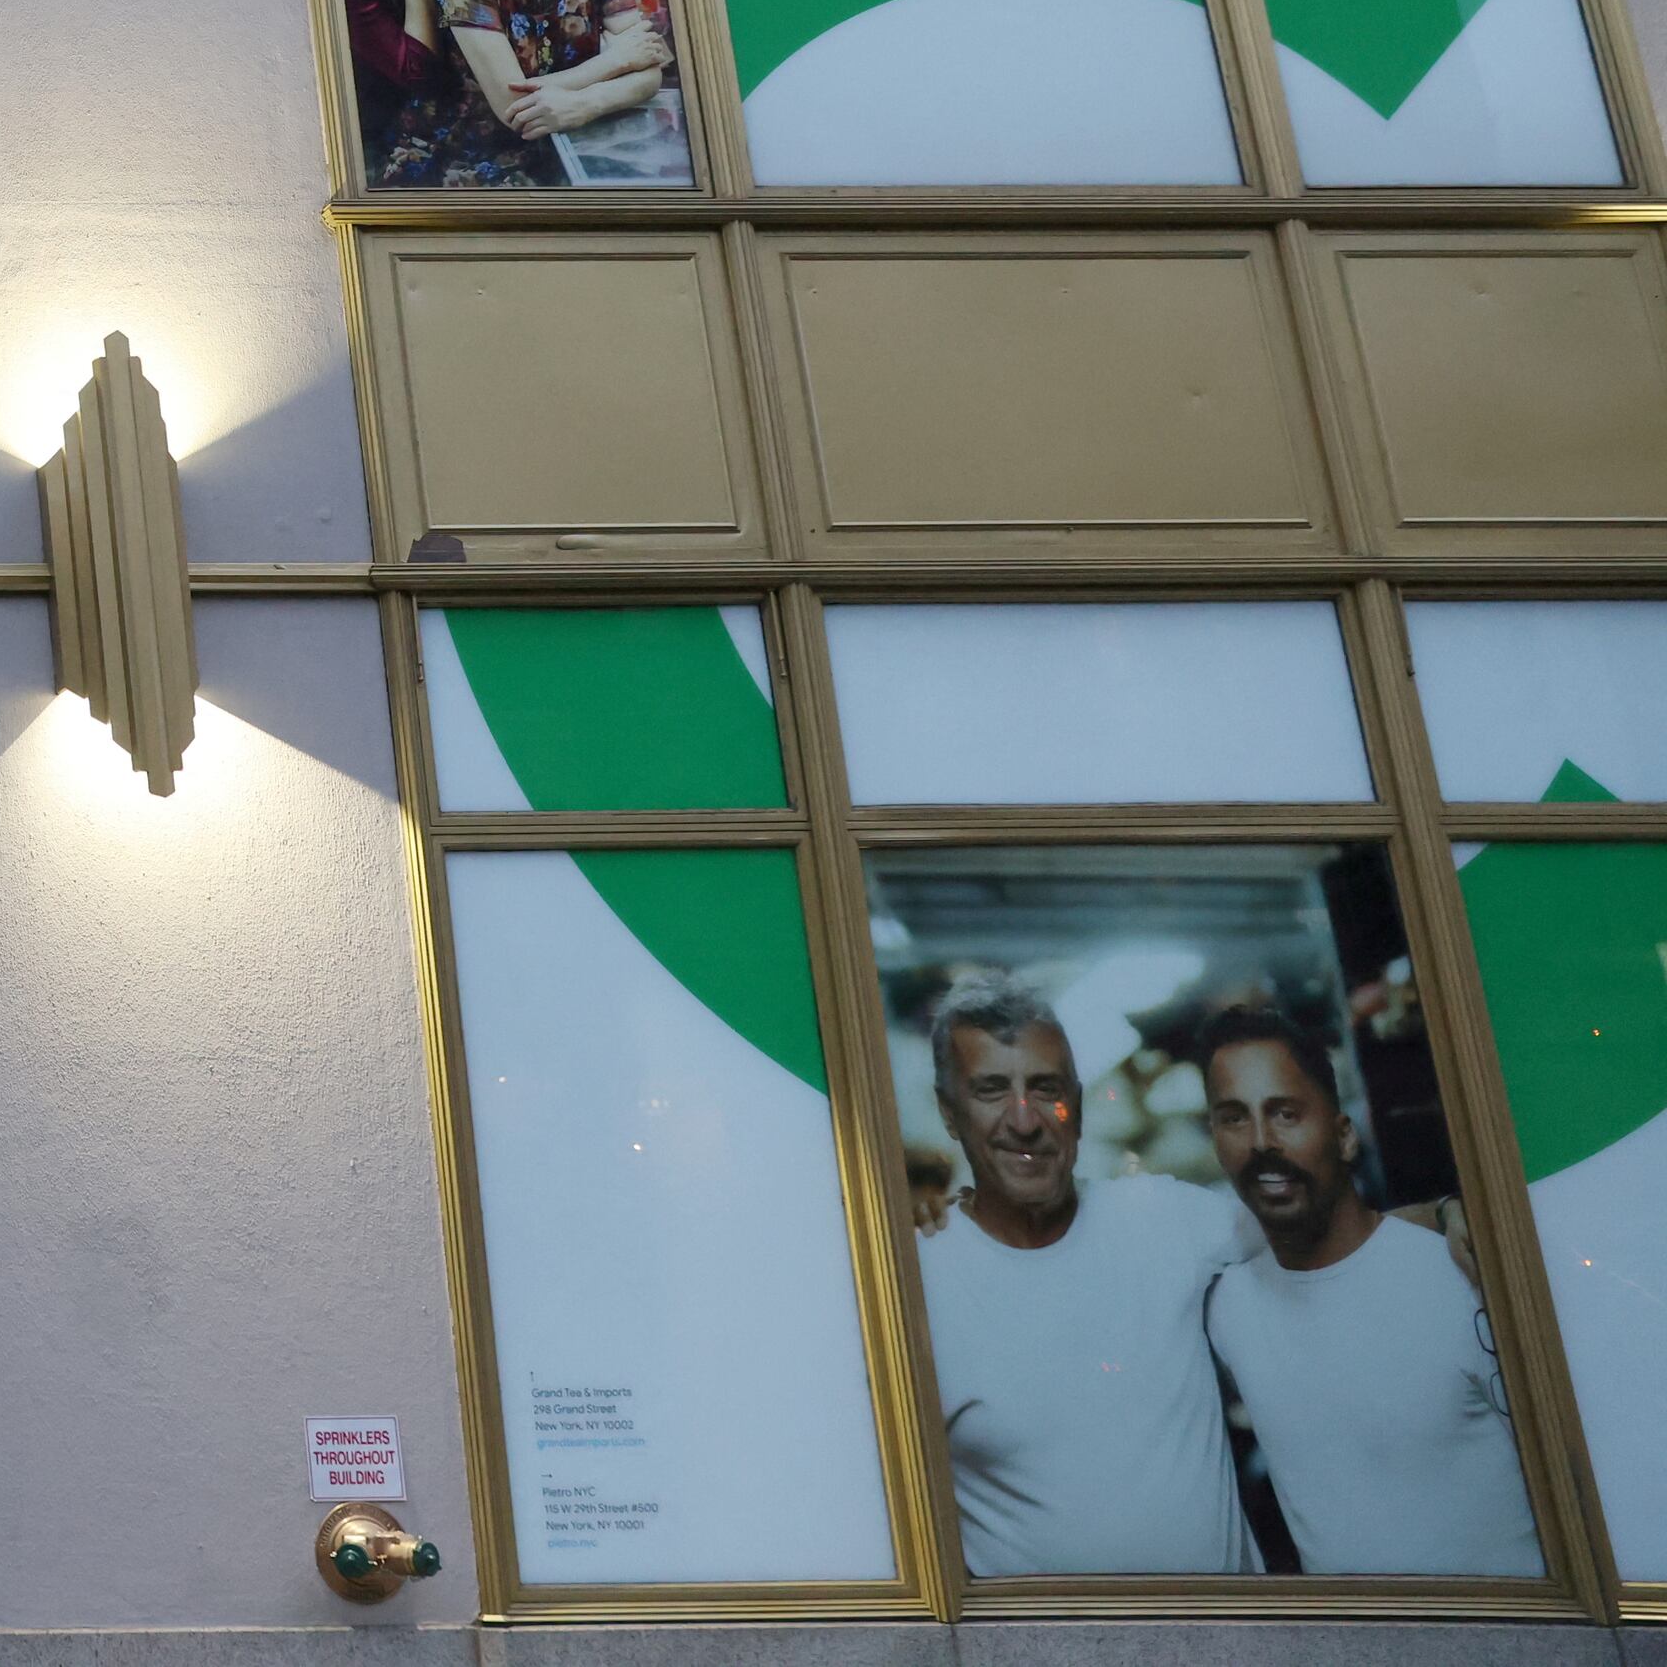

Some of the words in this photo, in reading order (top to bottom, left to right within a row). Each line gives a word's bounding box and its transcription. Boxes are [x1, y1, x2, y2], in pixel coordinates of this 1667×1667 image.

[531, 1388, 562, 1398] Grand
[565, 1388, 582, 1397] Tea
[584, 1388, 591, 1397] &
[593, 1388, 632, 1398] Imports
[554, 1404, 585, 1414] Grand
[587, 1404, 616, 1414] Street
[535, 1421, 557, 1431] New
[586, 1421, 599, 1430] NY
[316, 1431, 390, 1446] SPRINKLERS
[314, 1451, 395, 1465] THROUGHOUT
[329, 1471, 384, 1485] BUILDING
[542, 1487, 571, 1497] Pietro
[574, 1486, 595, 1497] NYC
[562, 1504, 571, 1513] W
[599, 1503, 628, 1513] Street
[546, 1521, 568, 1530] New
[597, 1520, 611, 1529] NY
